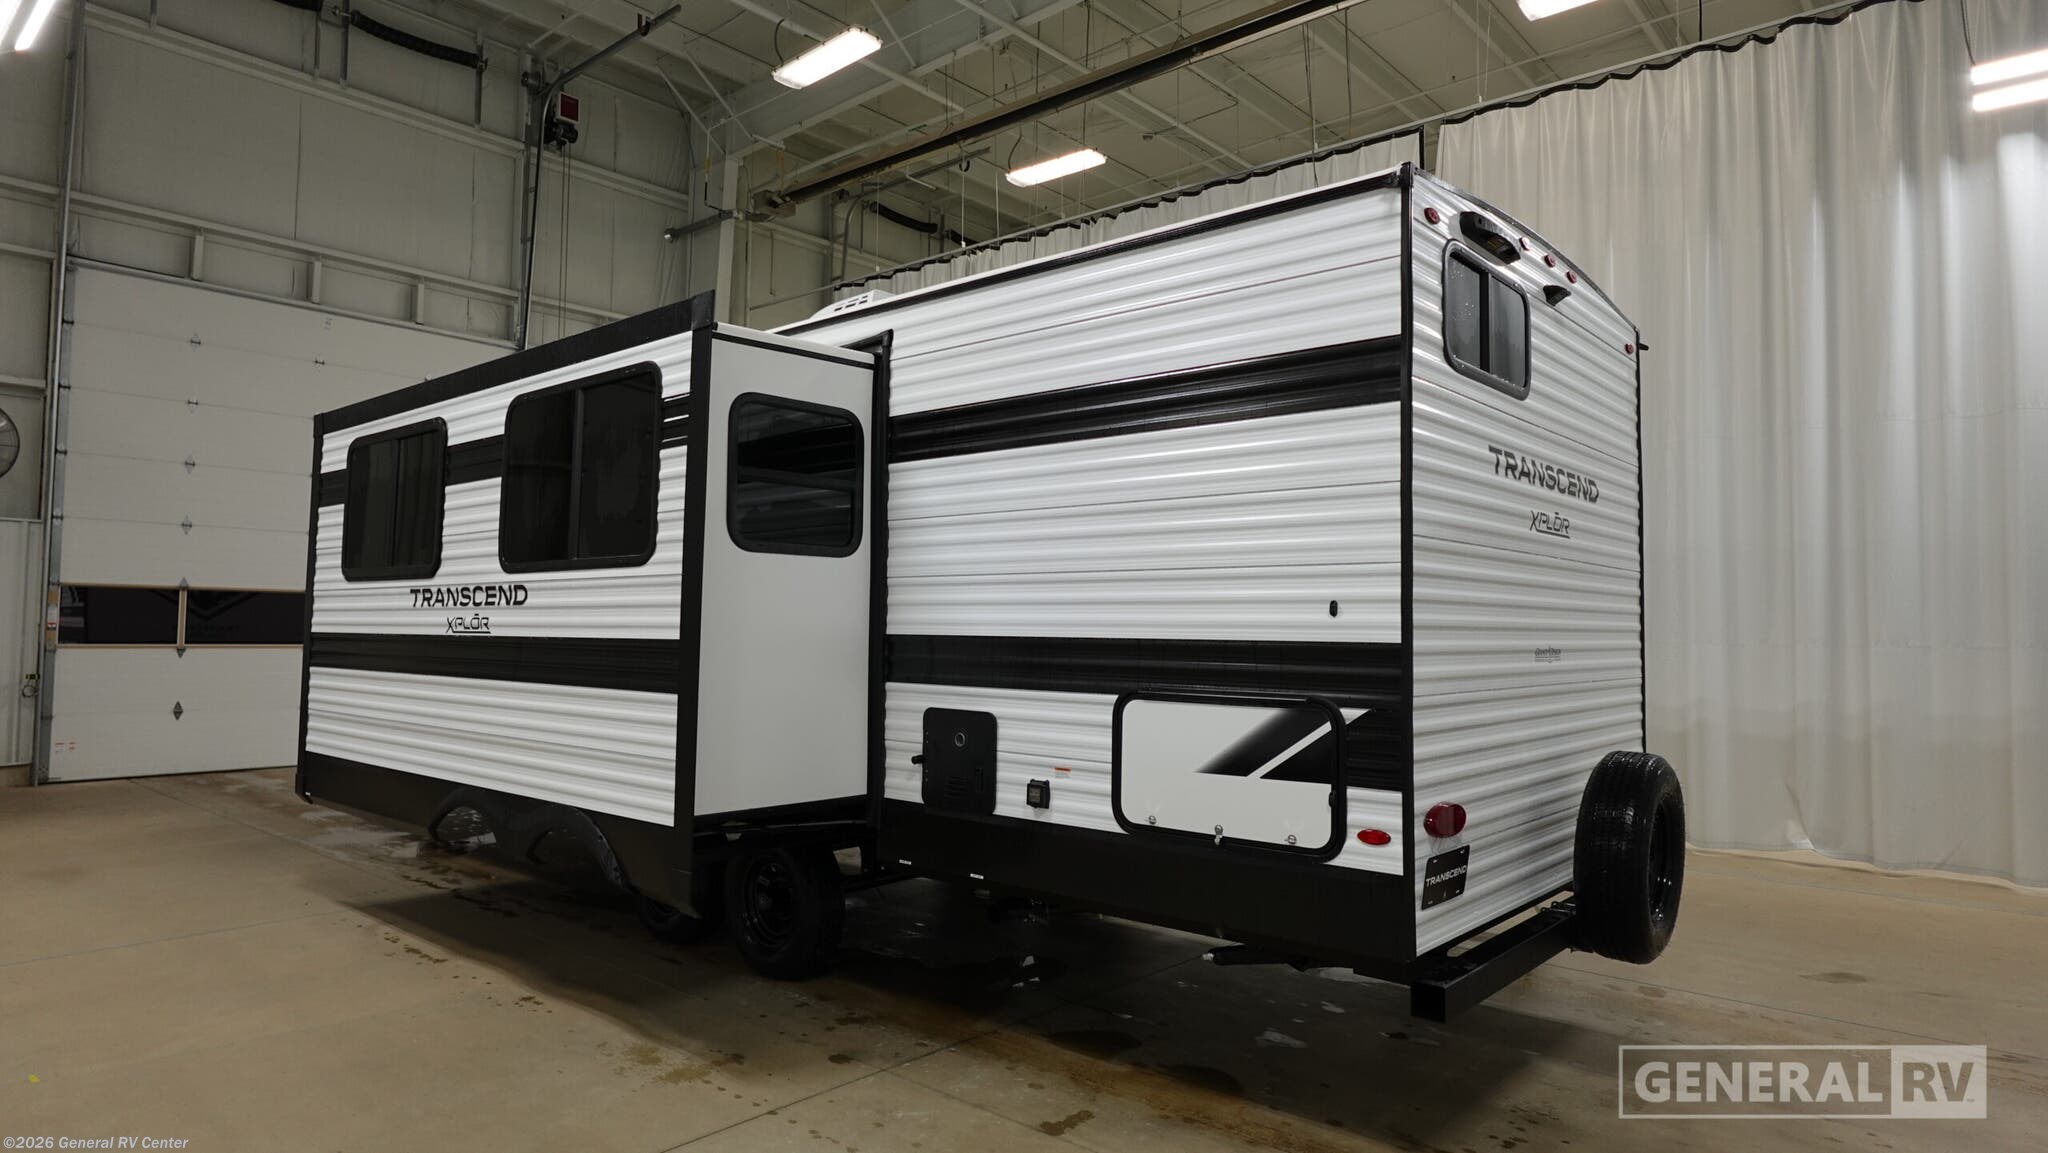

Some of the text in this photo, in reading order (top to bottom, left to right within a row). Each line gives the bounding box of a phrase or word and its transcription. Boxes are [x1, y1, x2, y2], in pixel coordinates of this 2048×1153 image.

[1488, 444, 1600, 504] TRANSCEND
[410, 584, 528, 608] TRANSCEND
[1425, 864, 1467, 888] TRANSCEND
